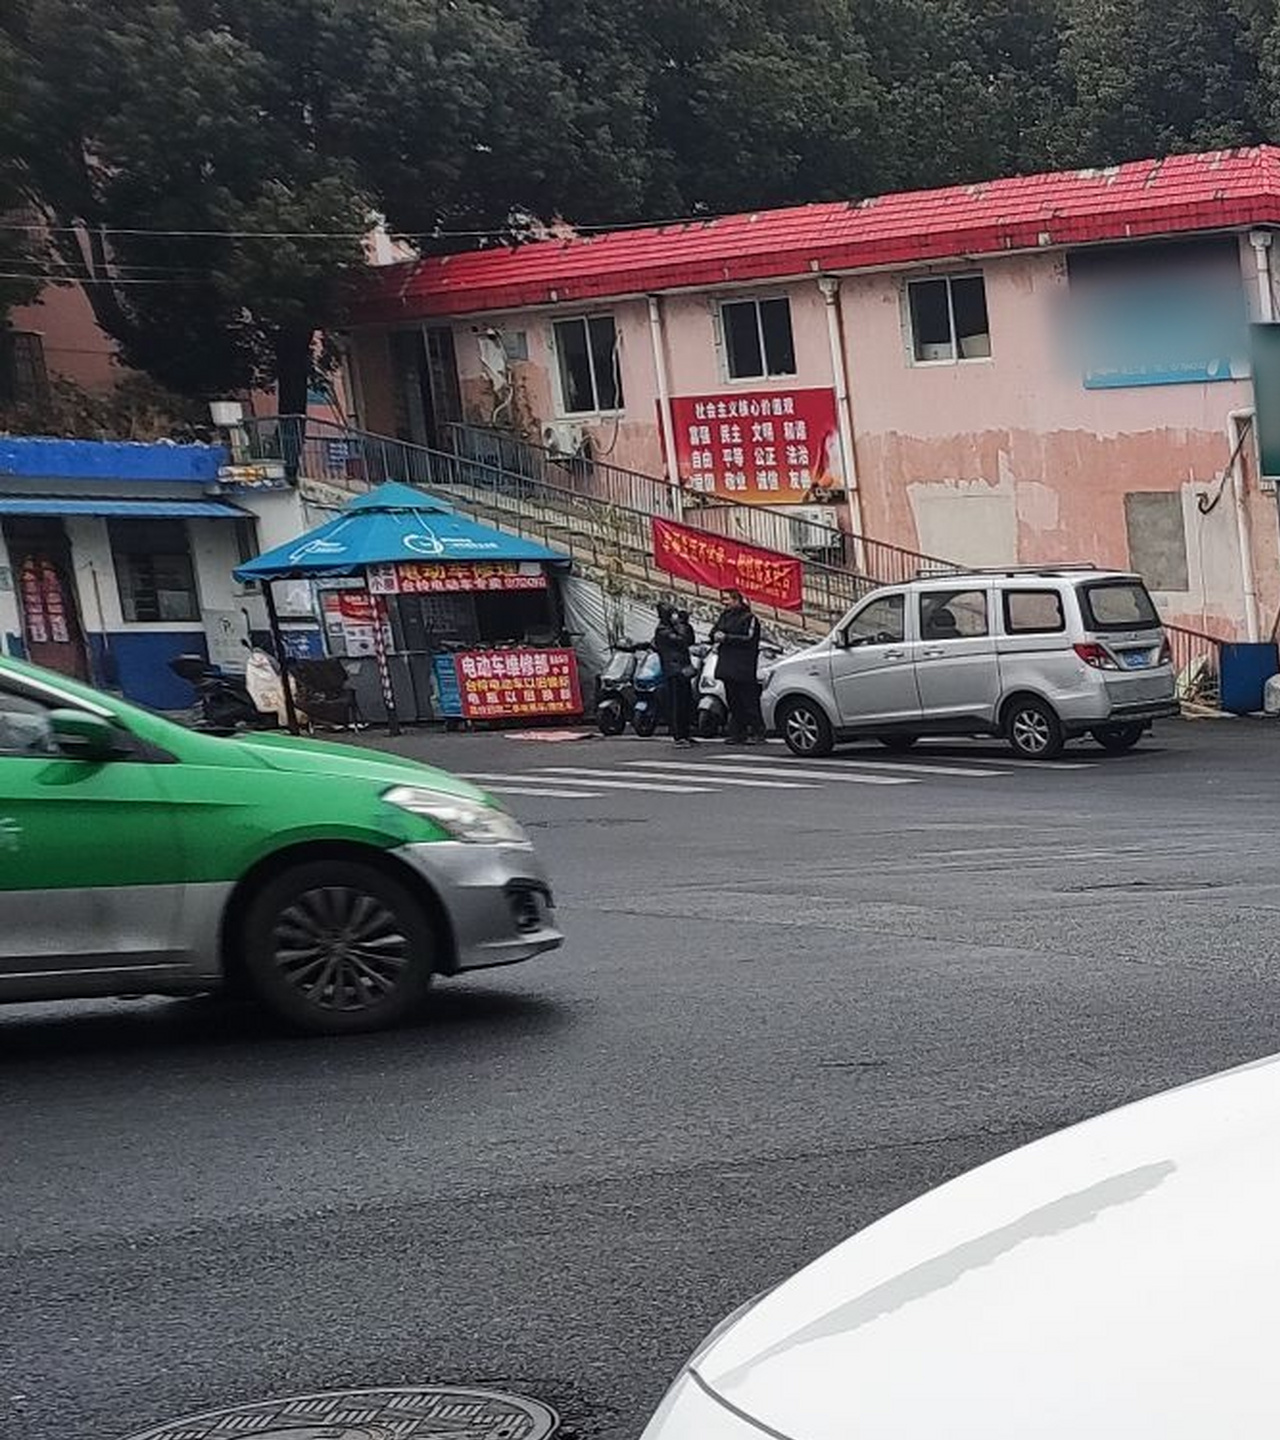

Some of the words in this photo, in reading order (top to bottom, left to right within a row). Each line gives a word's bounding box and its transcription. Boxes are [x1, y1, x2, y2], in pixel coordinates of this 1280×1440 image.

[695, 397, 795, 420] 社会主义核心价值观
[689, 426, 711, 445] 富强
[720, 424, 743, 444] 民主
[751, 422, 774, 442] 文明
[783, 420, 806, 441] 和谐
[692, 449, 713, 469] 自由
[722, 447, 744, 468] 平等
[754, 446, 777, 466] 公正
[786, 445, 809, 466] 法治
[724, 472, 747, 490] 敬业
[756, 470, 779, 490] 诚信
[461, 654, 550, 679] 电动车维修部
